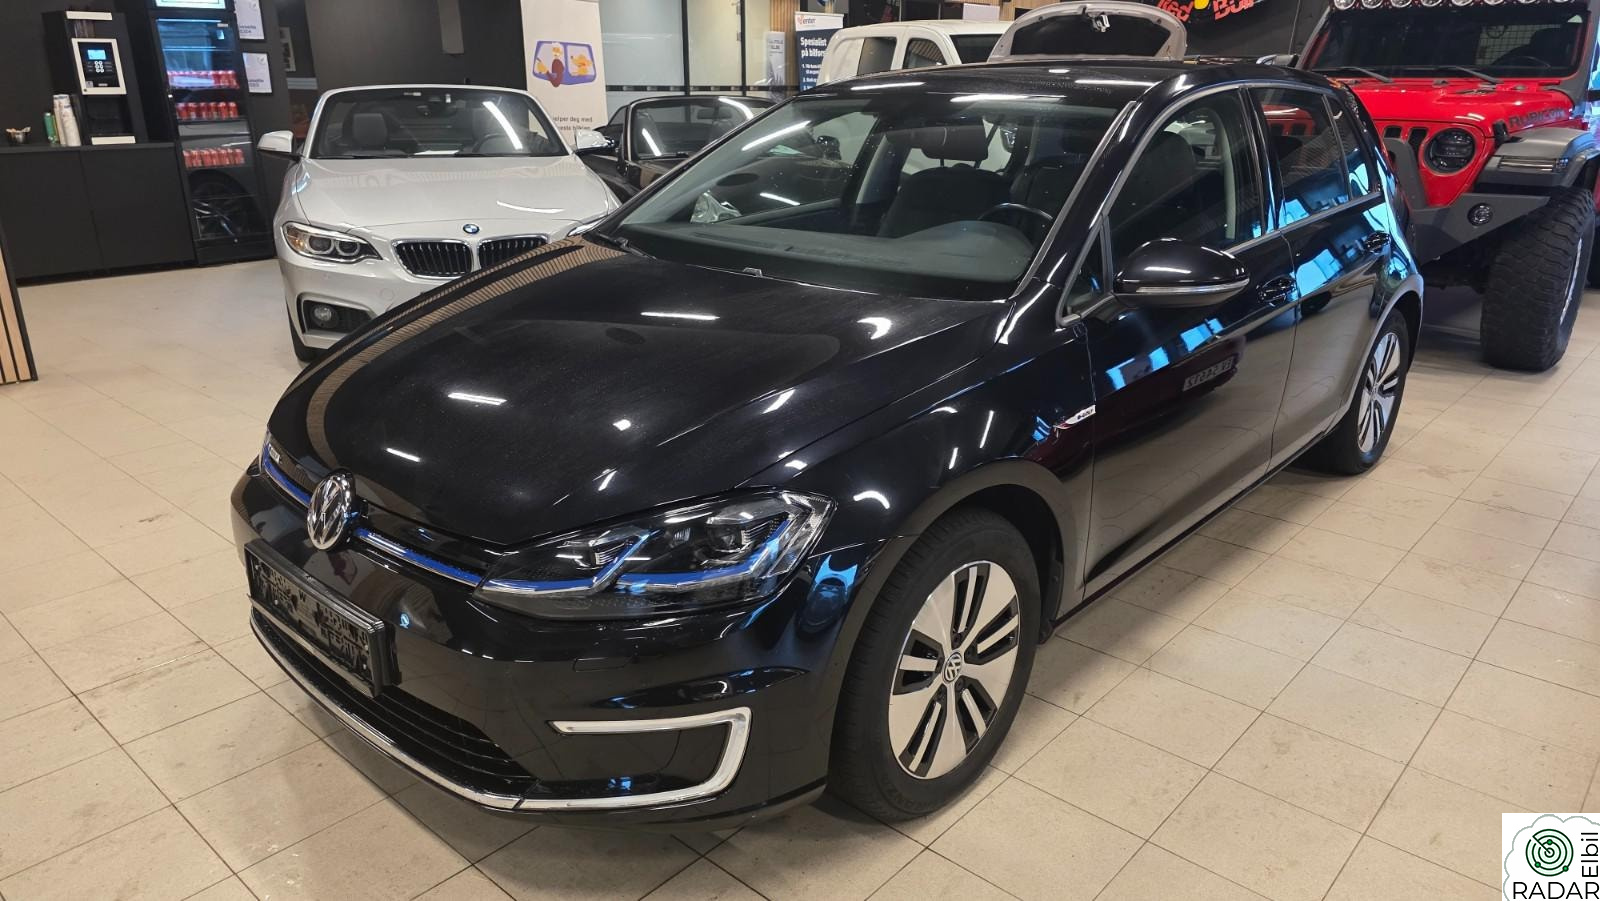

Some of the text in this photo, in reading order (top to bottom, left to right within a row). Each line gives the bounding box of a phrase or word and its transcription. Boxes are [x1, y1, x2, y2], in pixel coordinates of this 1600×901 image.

[800, 37, 827, 47] Spesialist
[801, 48, 808, 59] på
[1510, 109, 1565, 126] RUBICON
